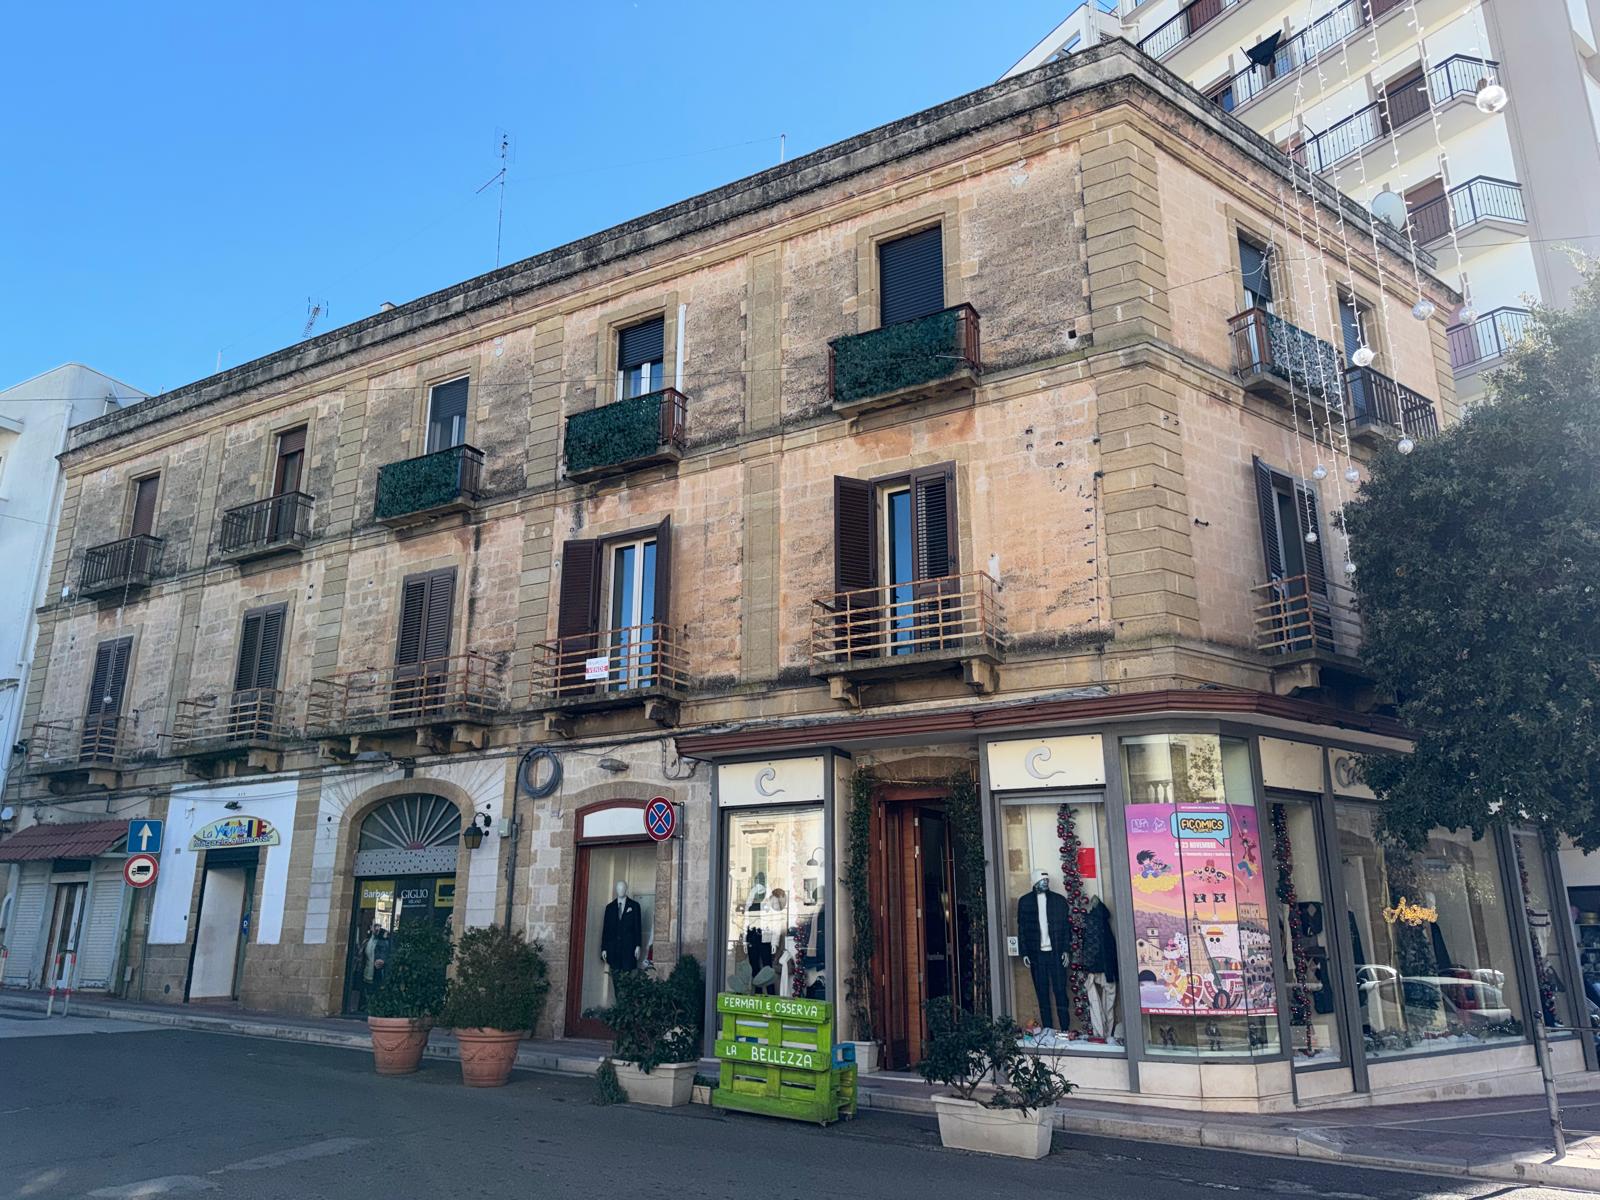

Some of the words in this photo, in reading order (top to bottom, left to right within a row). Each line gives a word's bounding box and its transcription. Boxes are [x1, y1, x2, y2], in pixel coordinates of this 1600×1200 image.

[1181, 818, 1224, 830] FICOMICS
[400, 888, 429, 899] GIGLIO
[724, 997, 763, 1010] FERMATI
[766, 1002, 771, 1010] E
[774, 1003, 818, 1017] OSSERVA
[726, 1045, 737, 1056] LA
[751, 1046, 812, 1068] BELLEZZA
